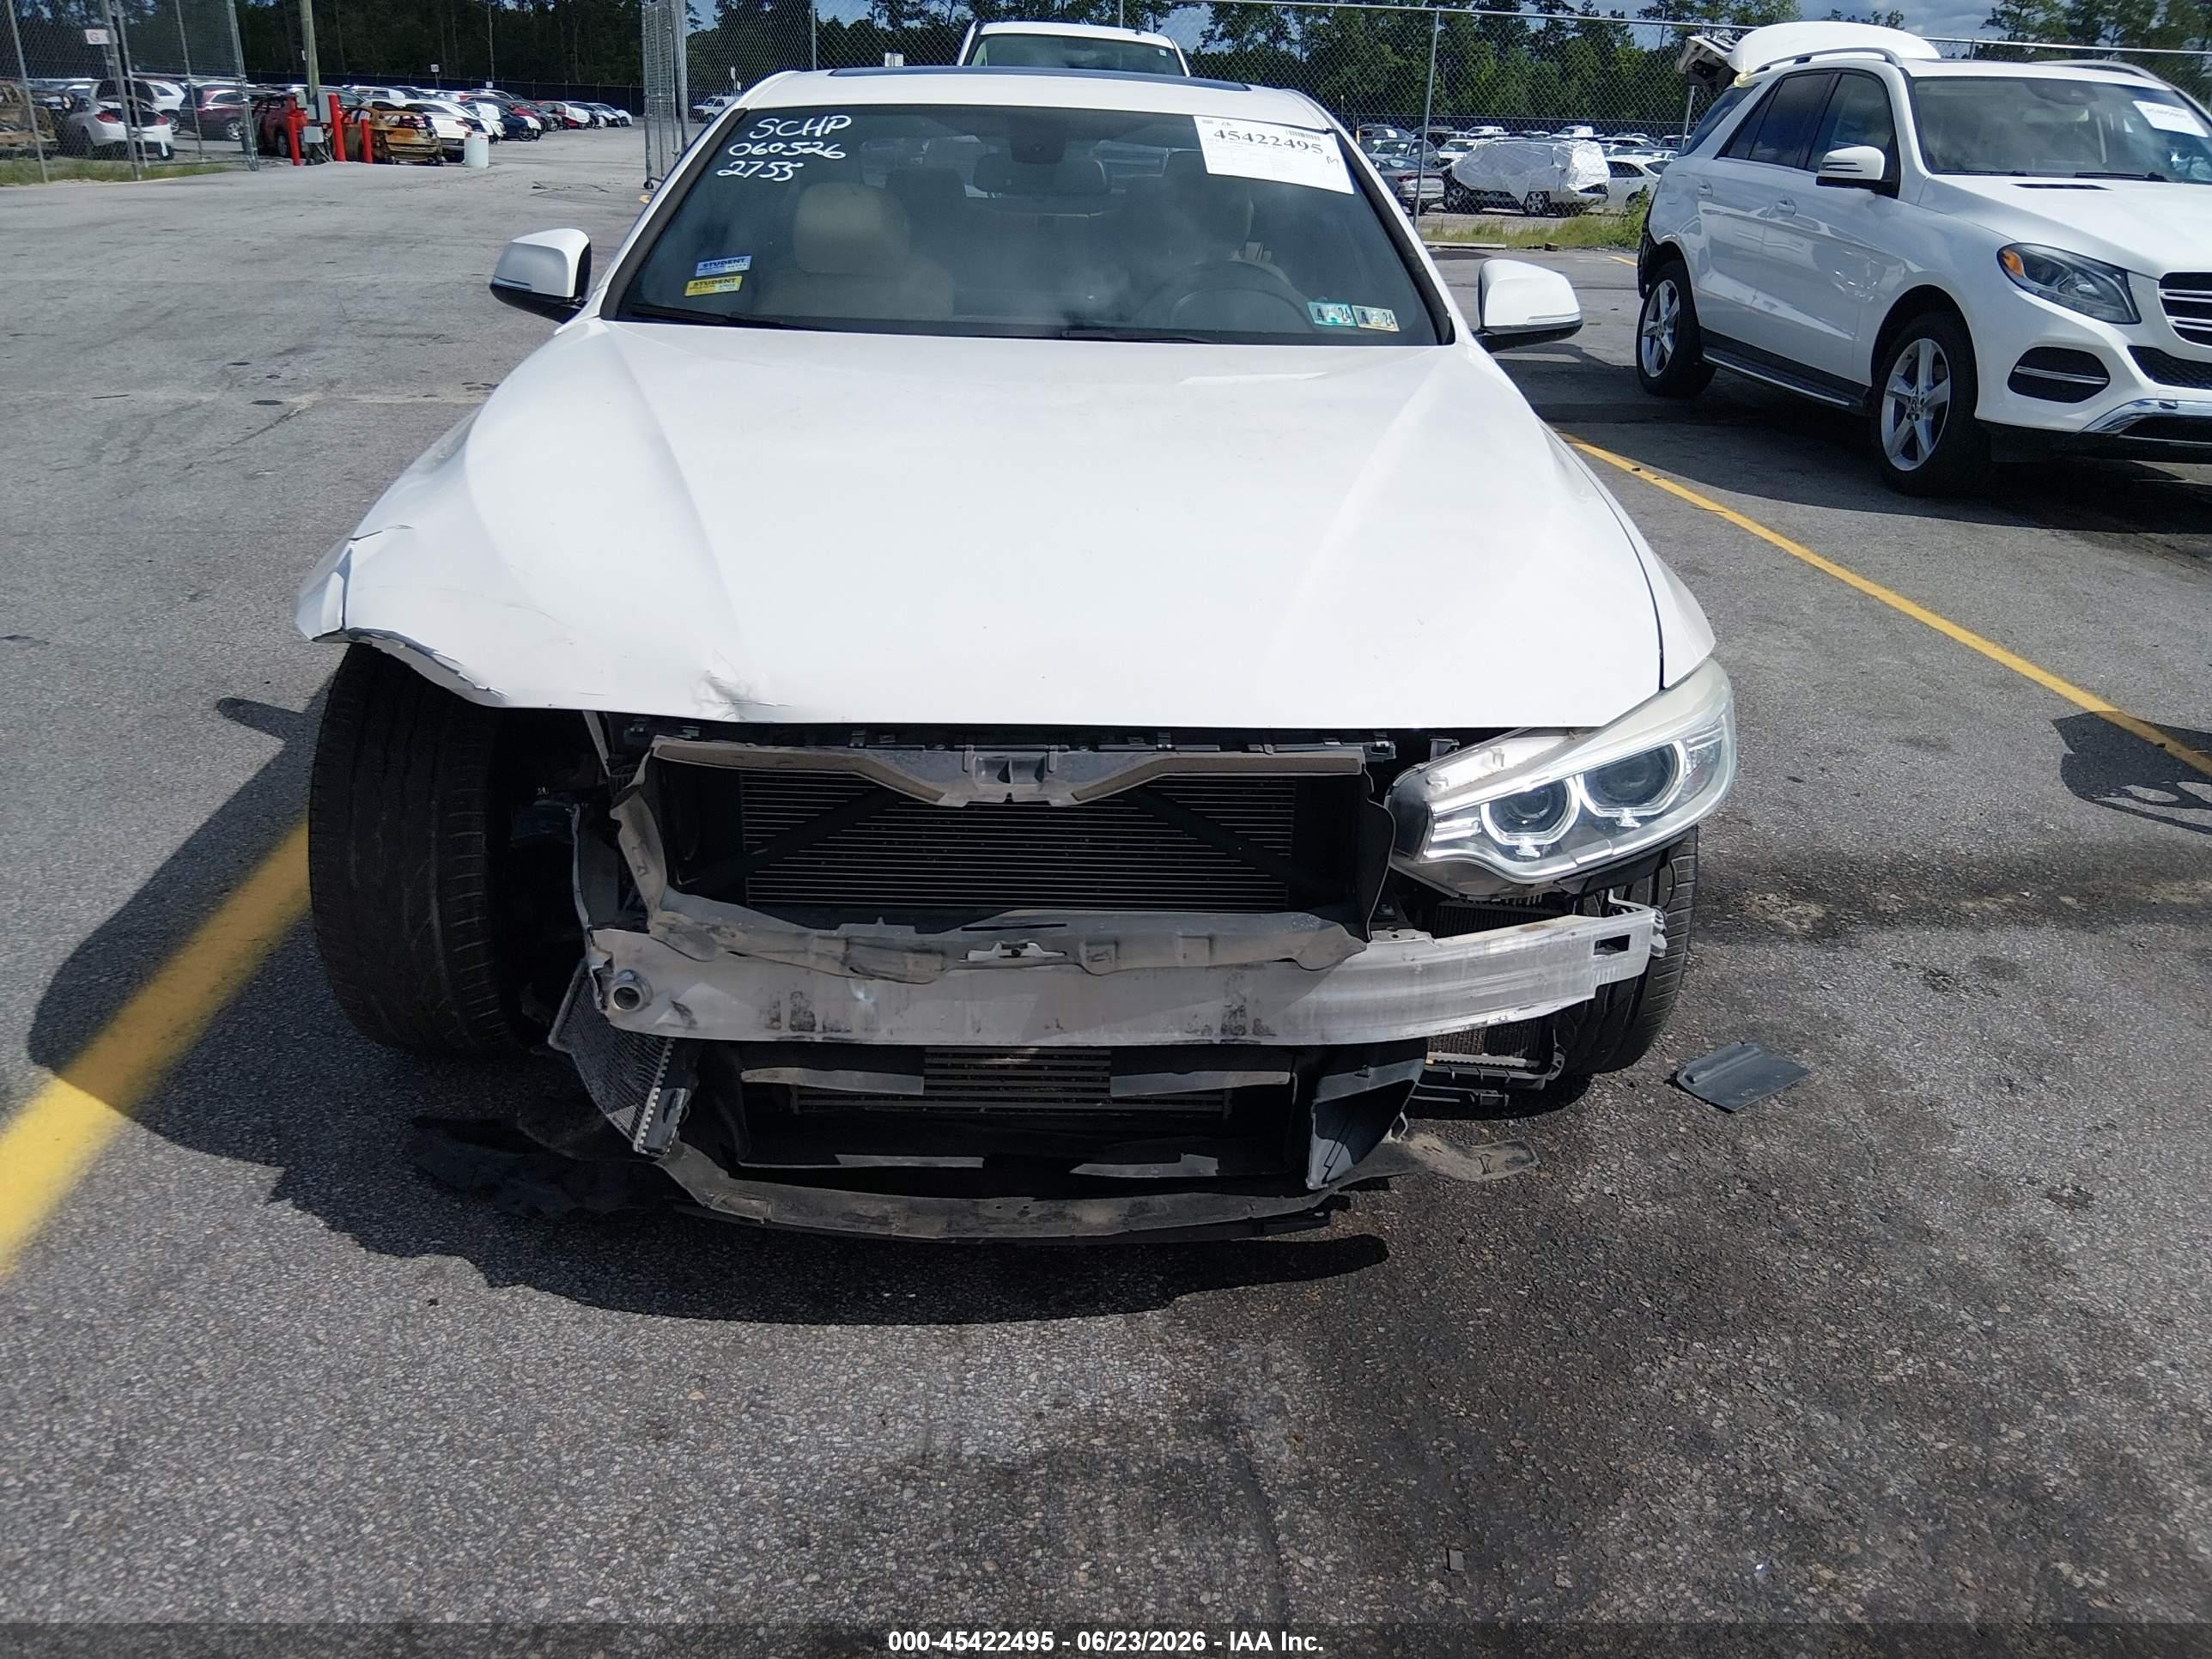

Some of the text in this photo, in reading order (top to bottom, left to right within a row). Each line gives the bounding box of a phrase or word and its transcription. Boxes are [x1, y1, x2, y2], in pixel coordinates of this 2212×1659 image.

[749, 114, 852, 139] SCHP
[728, 142, 846, 159] 060526
[1213, 130, 1323, 154] 45422495
[716, 161, 805, 182] 2755
[702, 258, 746, 268] STUDENT
[693, 277, 737, 287] STUDENT
